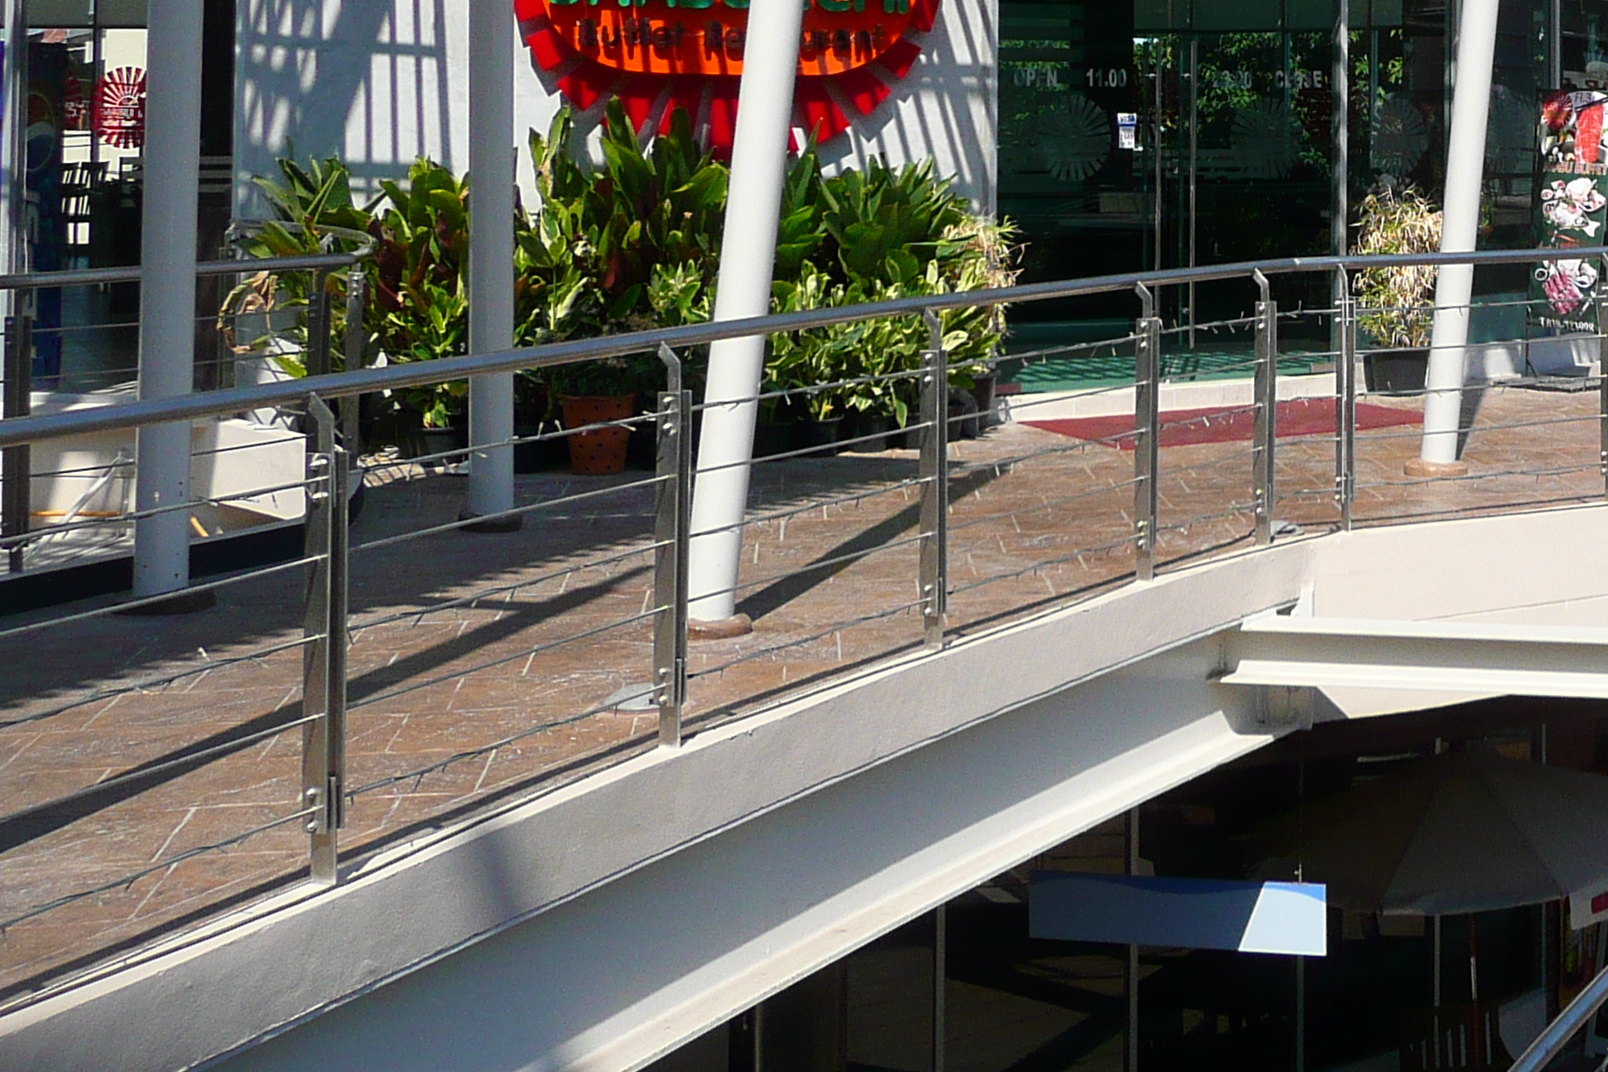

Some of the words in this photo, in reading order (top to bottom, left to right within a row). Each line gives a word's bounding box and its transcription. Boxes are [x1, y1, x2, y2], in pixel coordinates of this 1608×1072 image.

[577, 17, 684, 50] Buffet
[703, 19, 885, 53] Reurant
[1013, 67, 1058, 88] OPEN
[1086, 68, 1127, 88] 11.00
[1275, 70, 1322, 89] CLOSE
